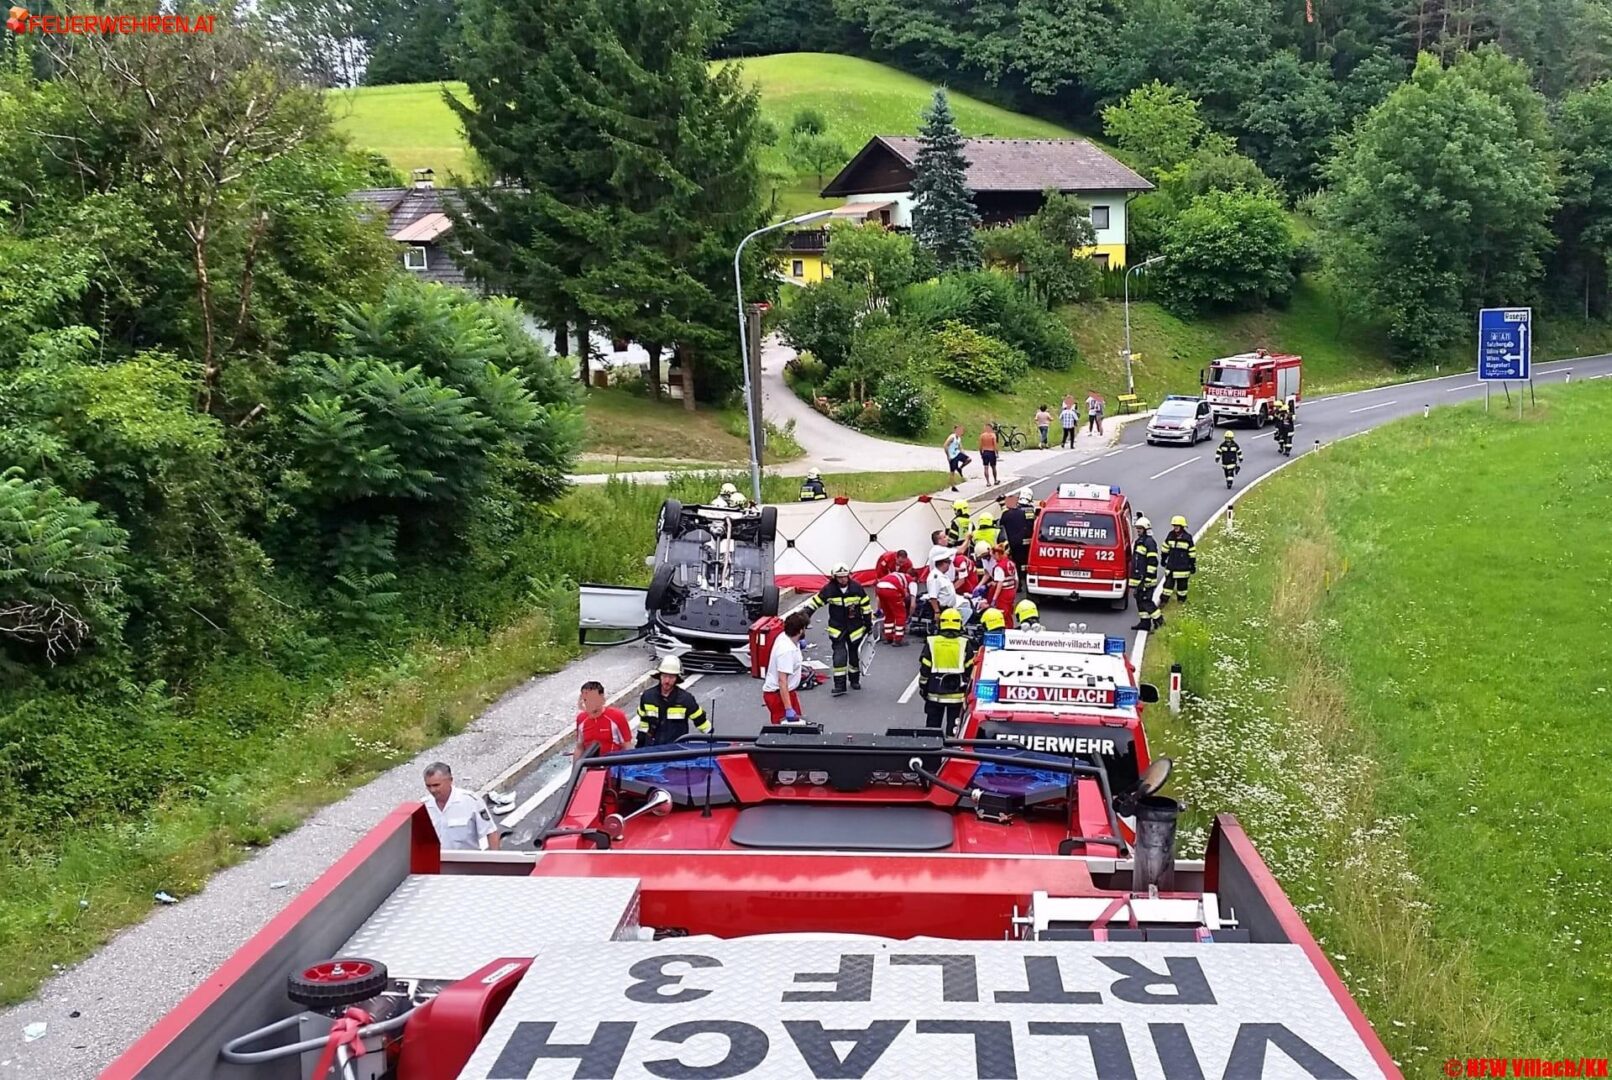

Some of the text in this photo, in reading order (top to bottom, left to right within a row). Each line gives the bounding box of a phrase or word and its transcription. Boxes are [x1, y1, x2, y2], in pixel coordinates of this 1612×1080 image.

[1049, 526, 1107, 539] FEUERWEHR
[1039, 547, 1115, 561] NOTRUF 122
[1009, 638, 1100, 650] www.feuerwehr-villach.at
[1006, 686, 1107, 703] KDO VILLACH
[624, 953, 1218, 1005] RTLF 3
[486, 1019, 1358, 1080] VILLACH
